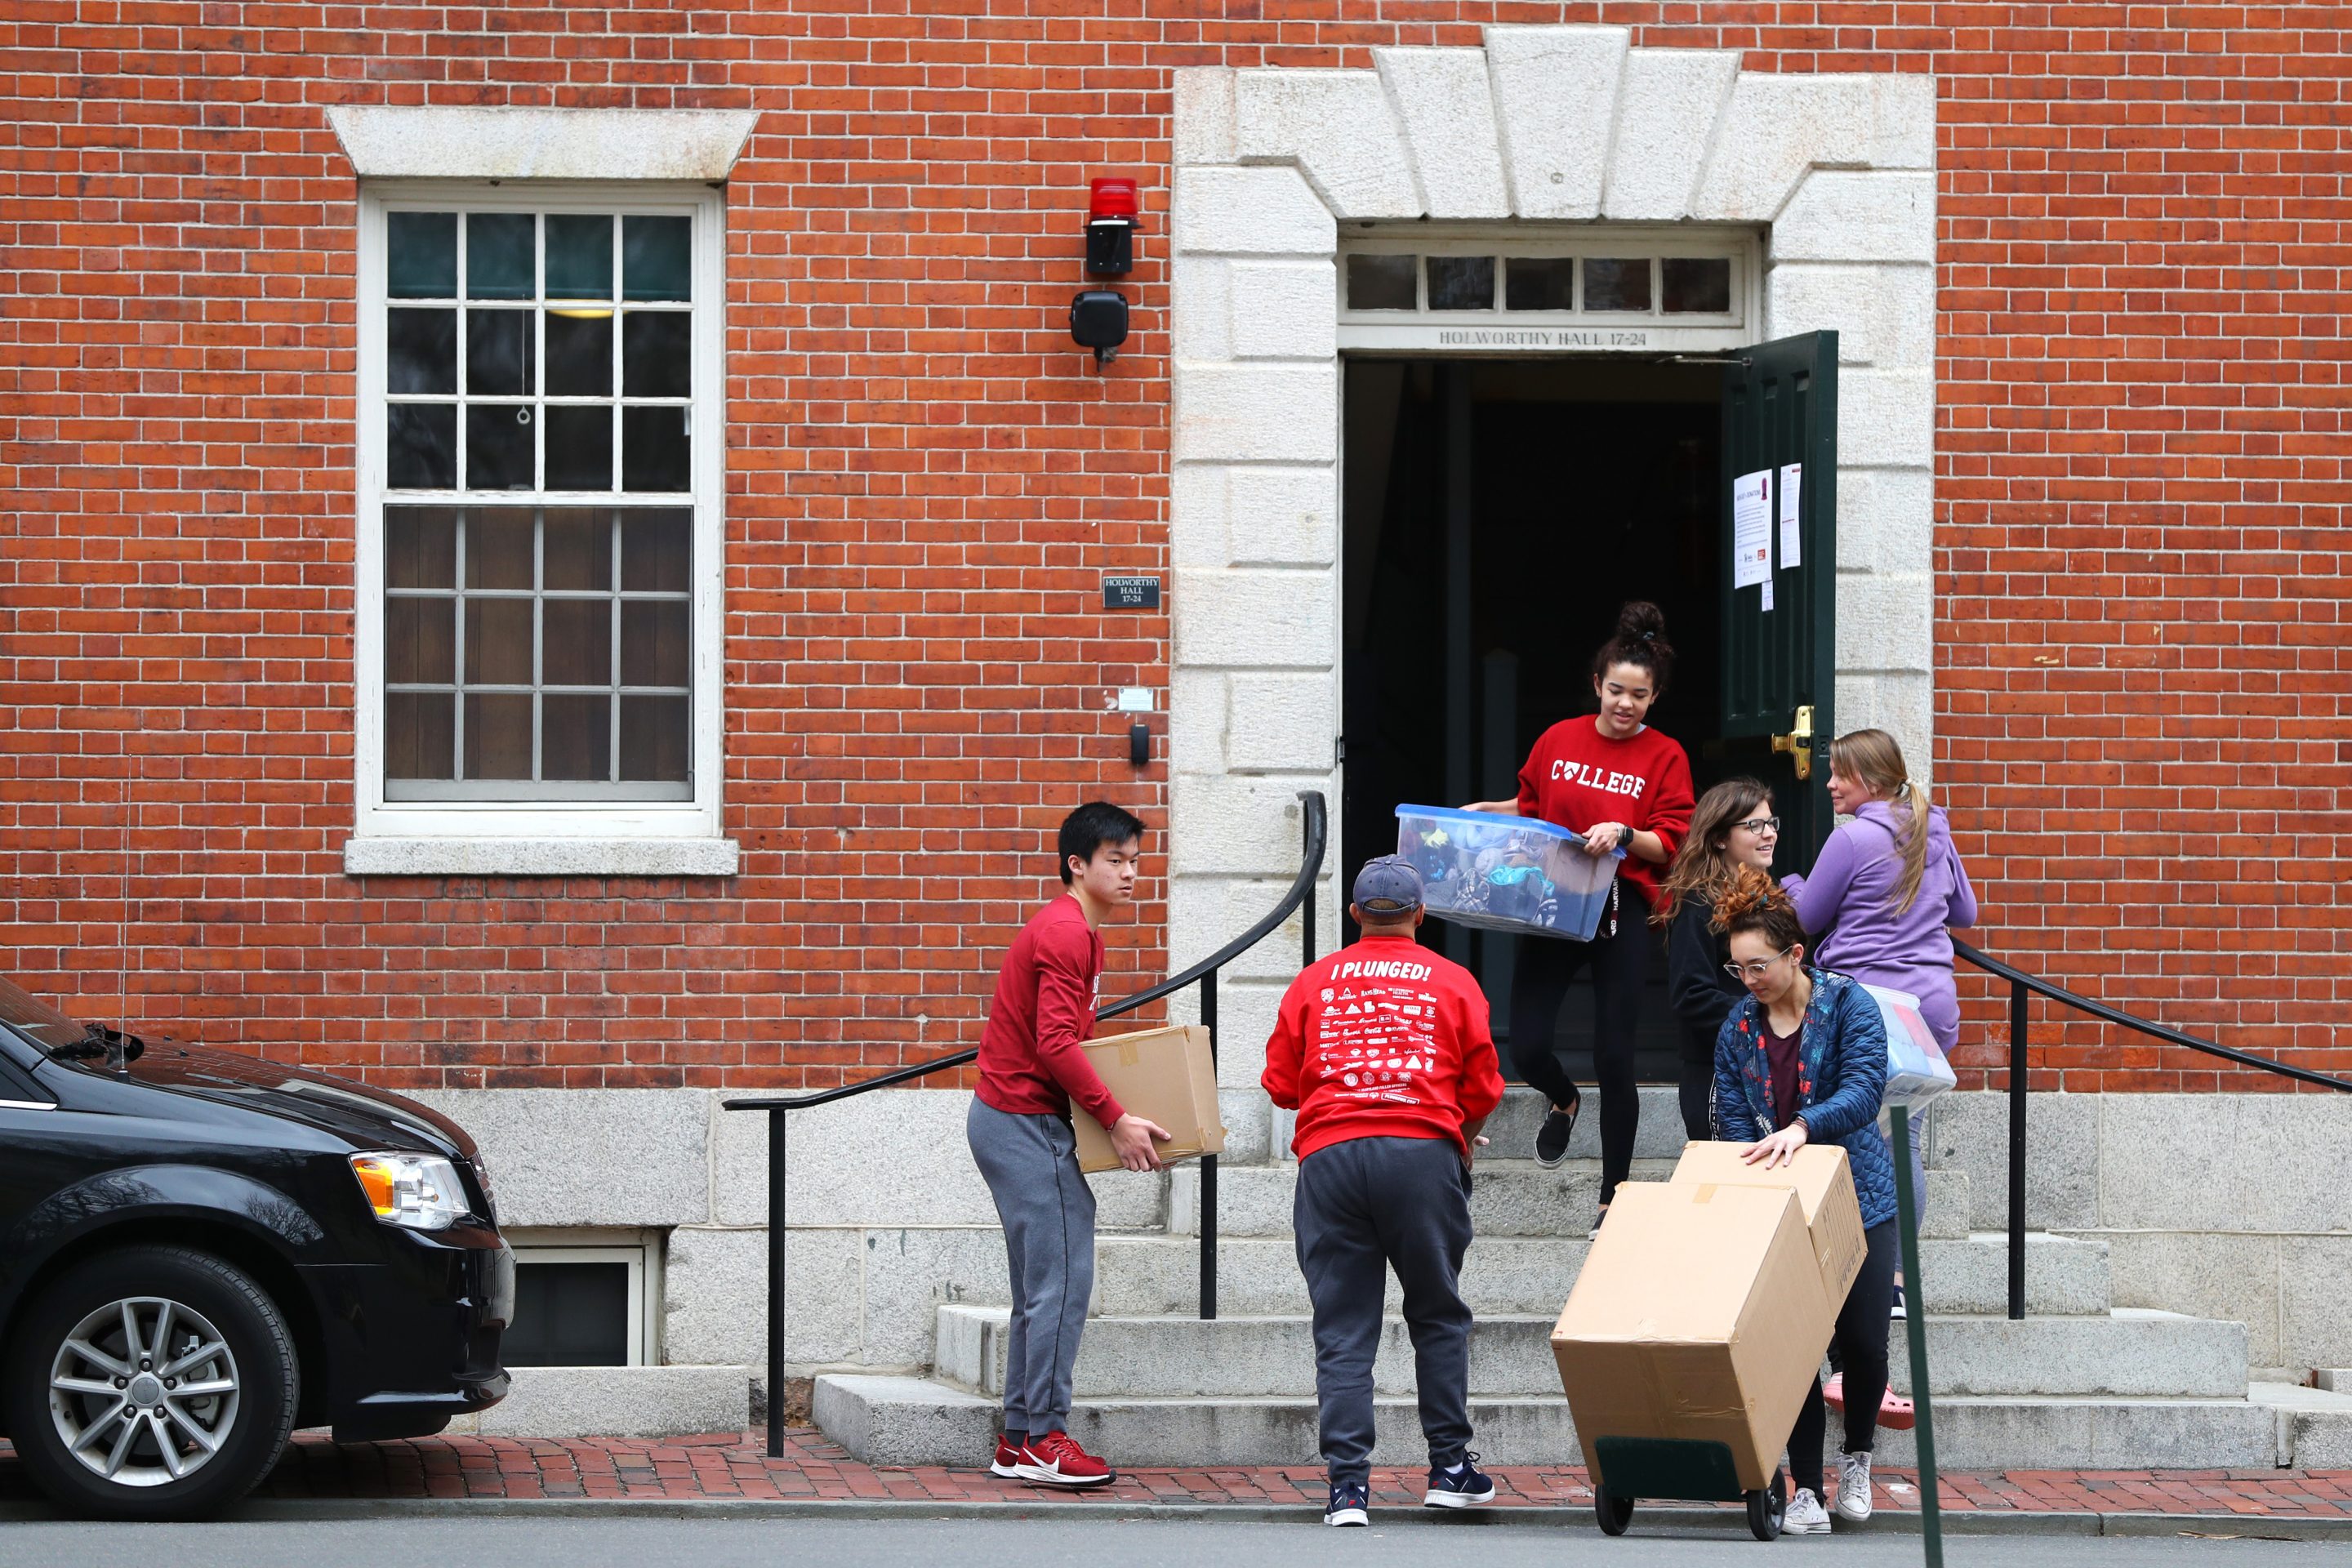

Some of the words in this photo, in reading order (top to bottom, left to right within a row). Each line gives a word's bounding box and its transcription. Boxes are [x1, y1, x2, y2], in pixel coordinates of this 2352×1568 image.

[1439, 332, 1552, 345] HOLWORTHY
[1558, 332, 1602, 345] HALL
[1610, 333, 1646, 346] 17-24
[1330, 964, 1340, 981] I
[1341, 960, 1432, 982] PLUNGED!
